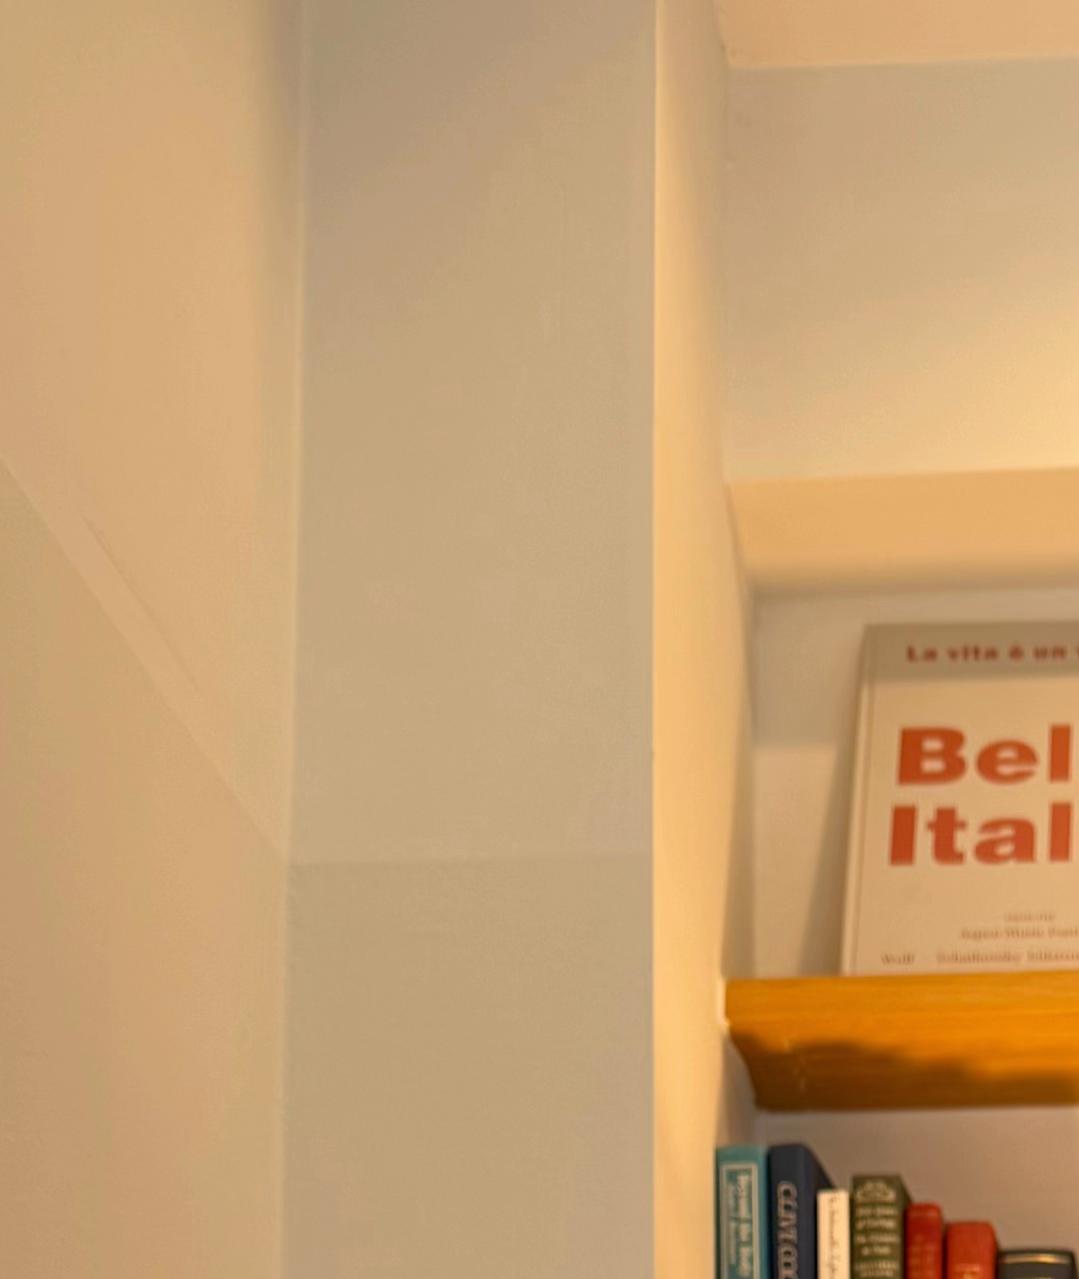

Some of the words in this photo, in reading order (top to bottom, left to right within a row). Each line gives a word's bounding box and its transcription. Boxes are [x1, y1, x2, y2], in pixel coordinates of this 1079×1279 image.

[906, 640, 939, 663] La
[946, 638, 999, 663] vita
[1031, 643, 1067, 662] un
